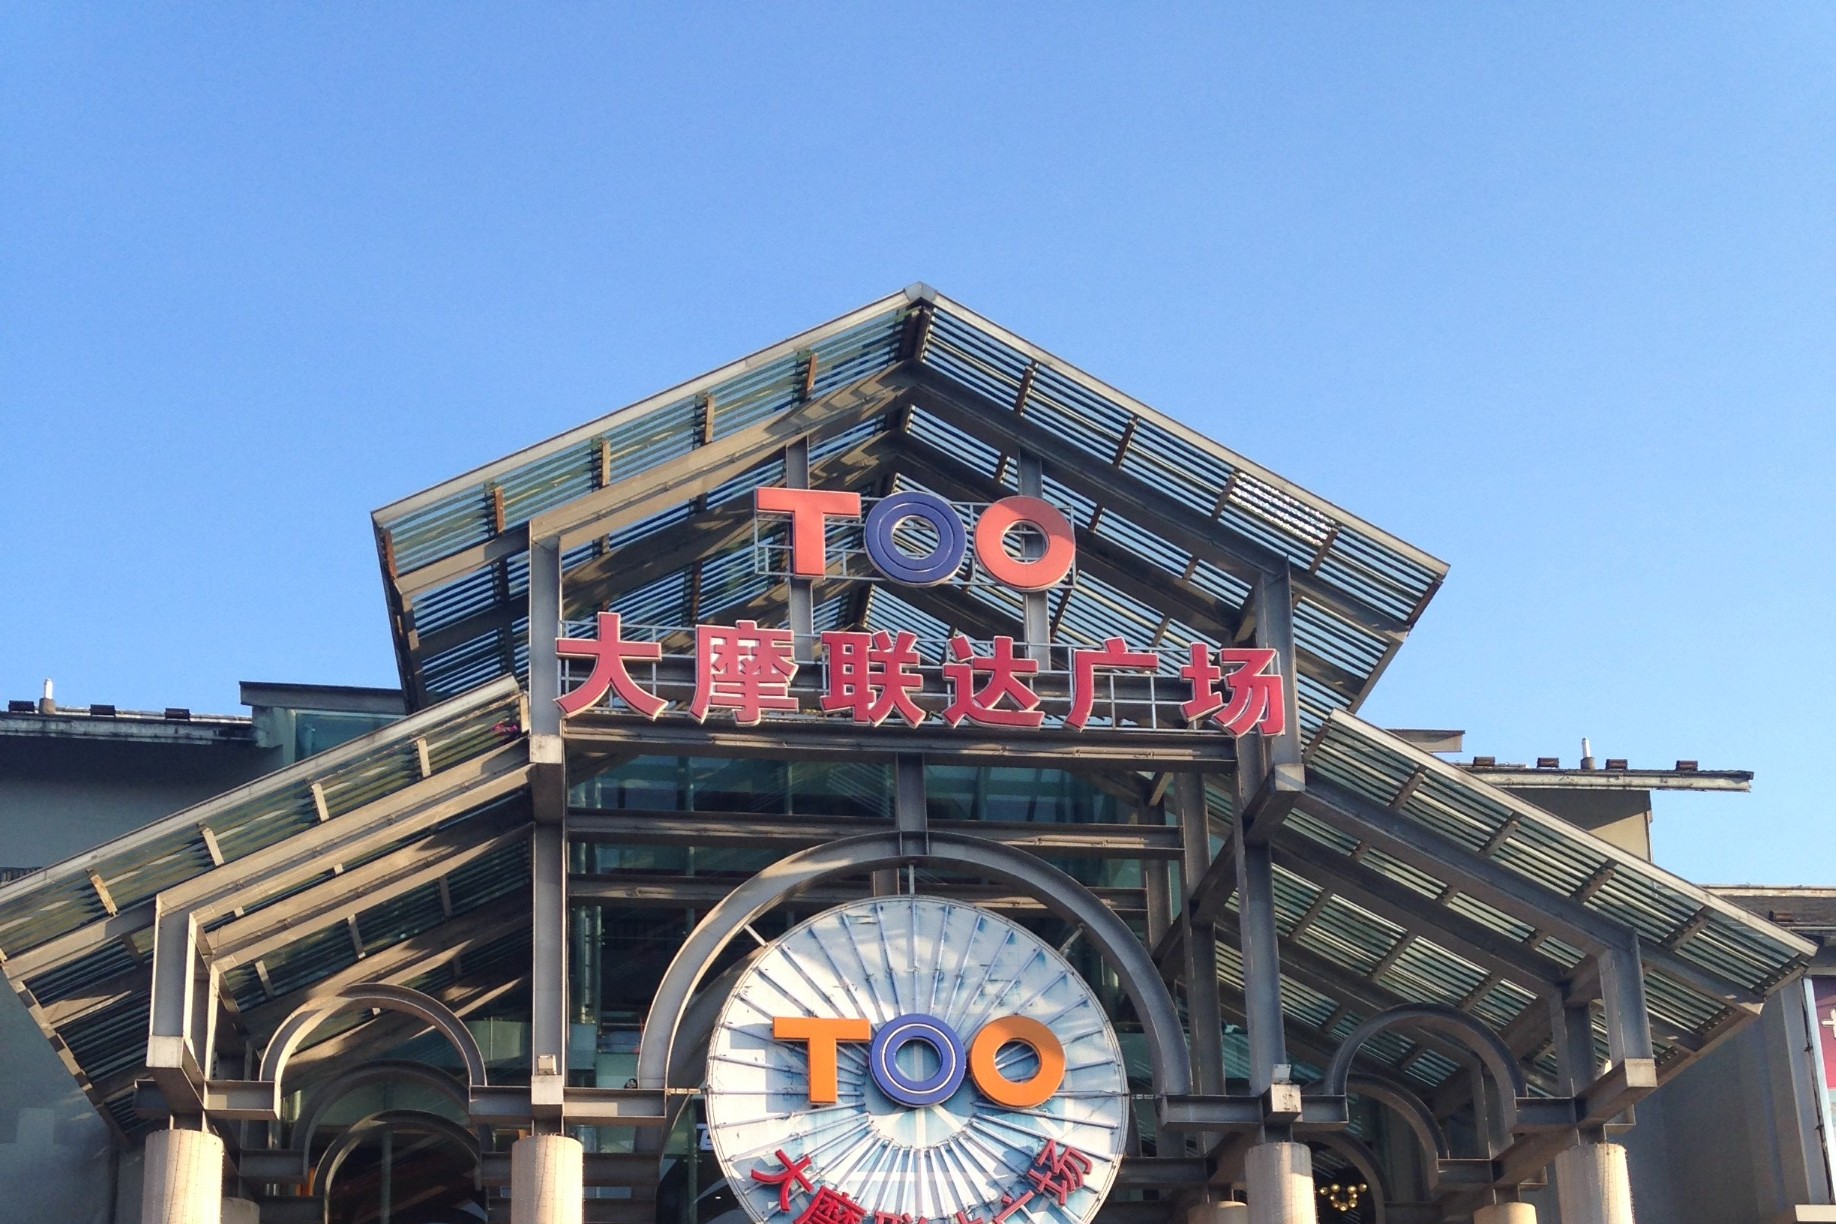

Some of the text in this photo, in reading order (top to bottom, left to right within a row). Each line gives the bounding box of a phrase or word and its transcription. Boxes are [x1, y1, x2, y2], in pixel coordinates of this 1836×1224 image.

[755, 486, 1077, 593] TOO
[554, 611, 1286, 738] 大摩联达广场
[772, 1013, 1066, 1108] TOO
